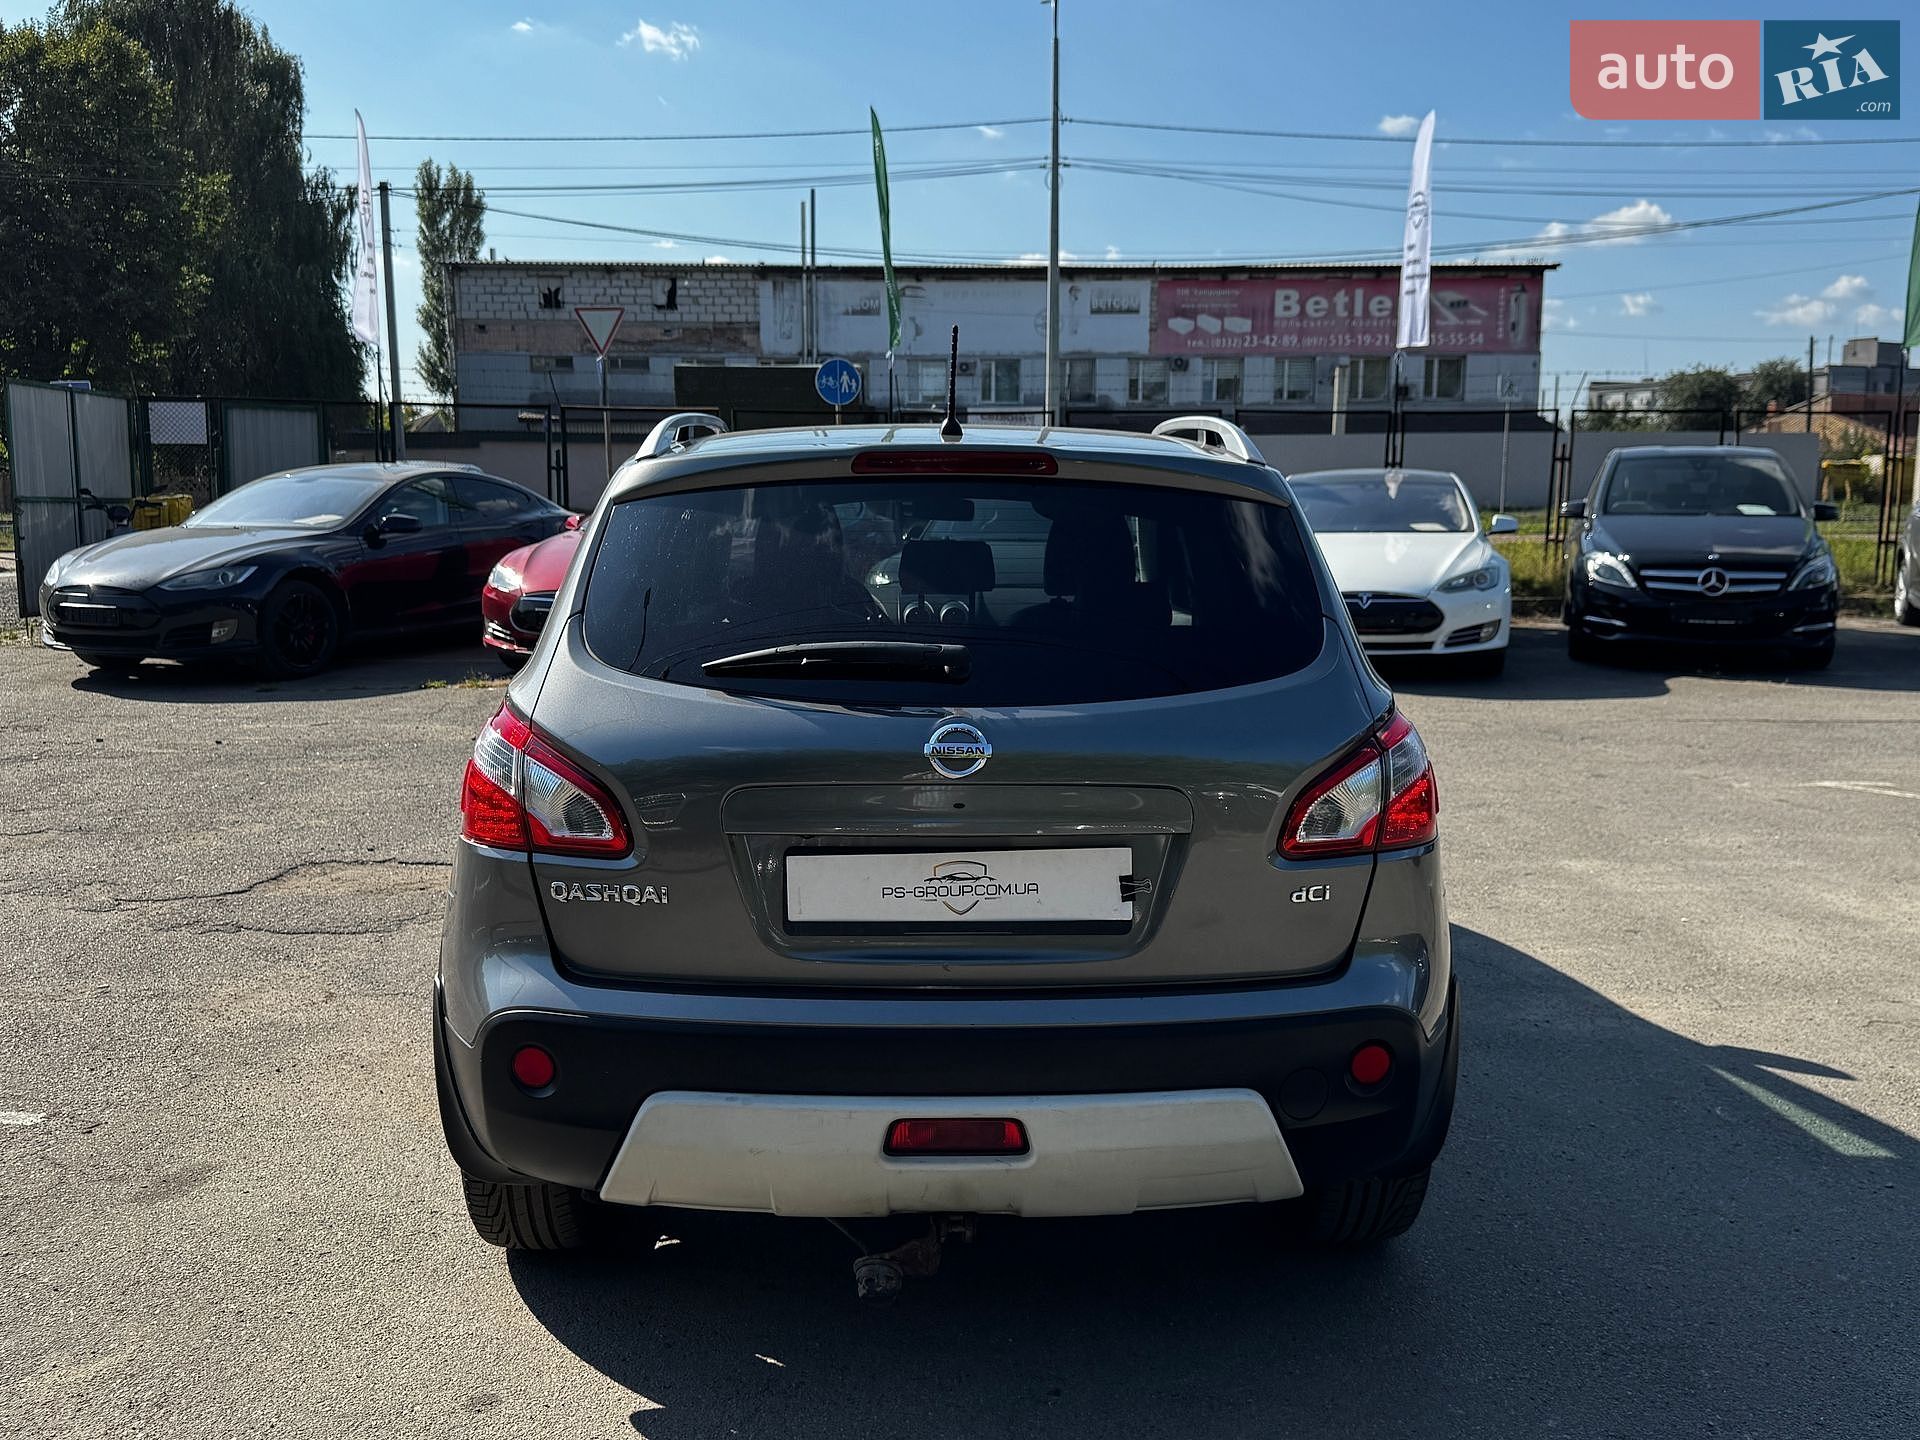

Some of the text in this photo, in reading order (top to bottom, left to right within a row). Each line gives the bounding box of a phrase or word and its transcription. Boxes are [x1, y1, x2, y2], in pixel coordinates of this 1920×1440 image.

[931, 746, 985, 755] NISSAN
[550, 881, 669, 906] QASHQAI
[881, 882, 1039, 899] PS-GROUP.COM.UA
[1291, 885, 1330, 903] dCi
